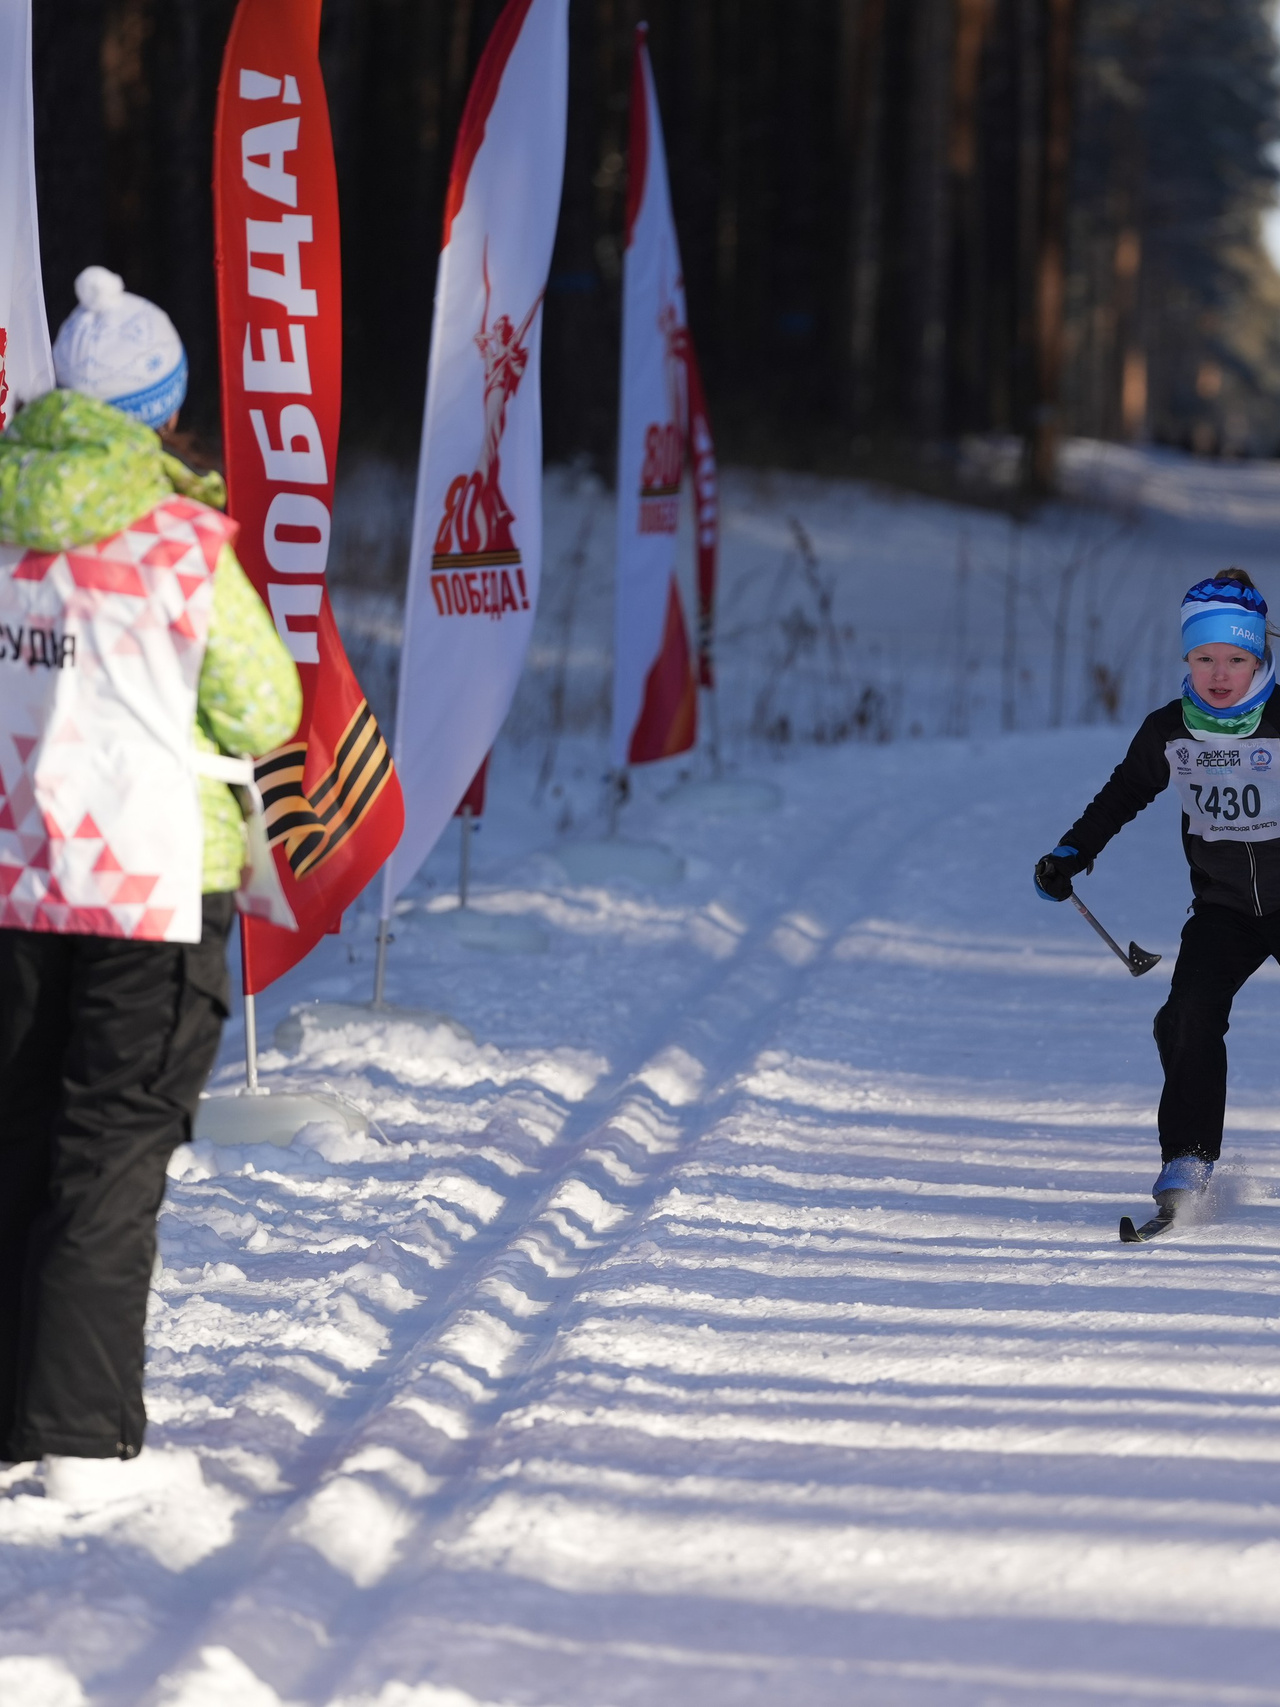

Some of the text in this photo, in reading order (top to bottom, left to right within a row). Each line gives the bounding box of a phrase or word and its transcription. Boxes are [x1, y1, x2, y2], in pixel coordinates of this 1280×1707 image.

[239, 67, 331, 665] ПОБЕДА!
[430, 568, 531, 621] ПОБЕДА!
[1196, 758, 1241, 768] РОССИИ
[1197, 750, 1240, 760] ЛЫЖНЯ
[1189, 783, 1261, 821] 7430
[1251, 820, 1278, 831] ОБЛАСТЬ
